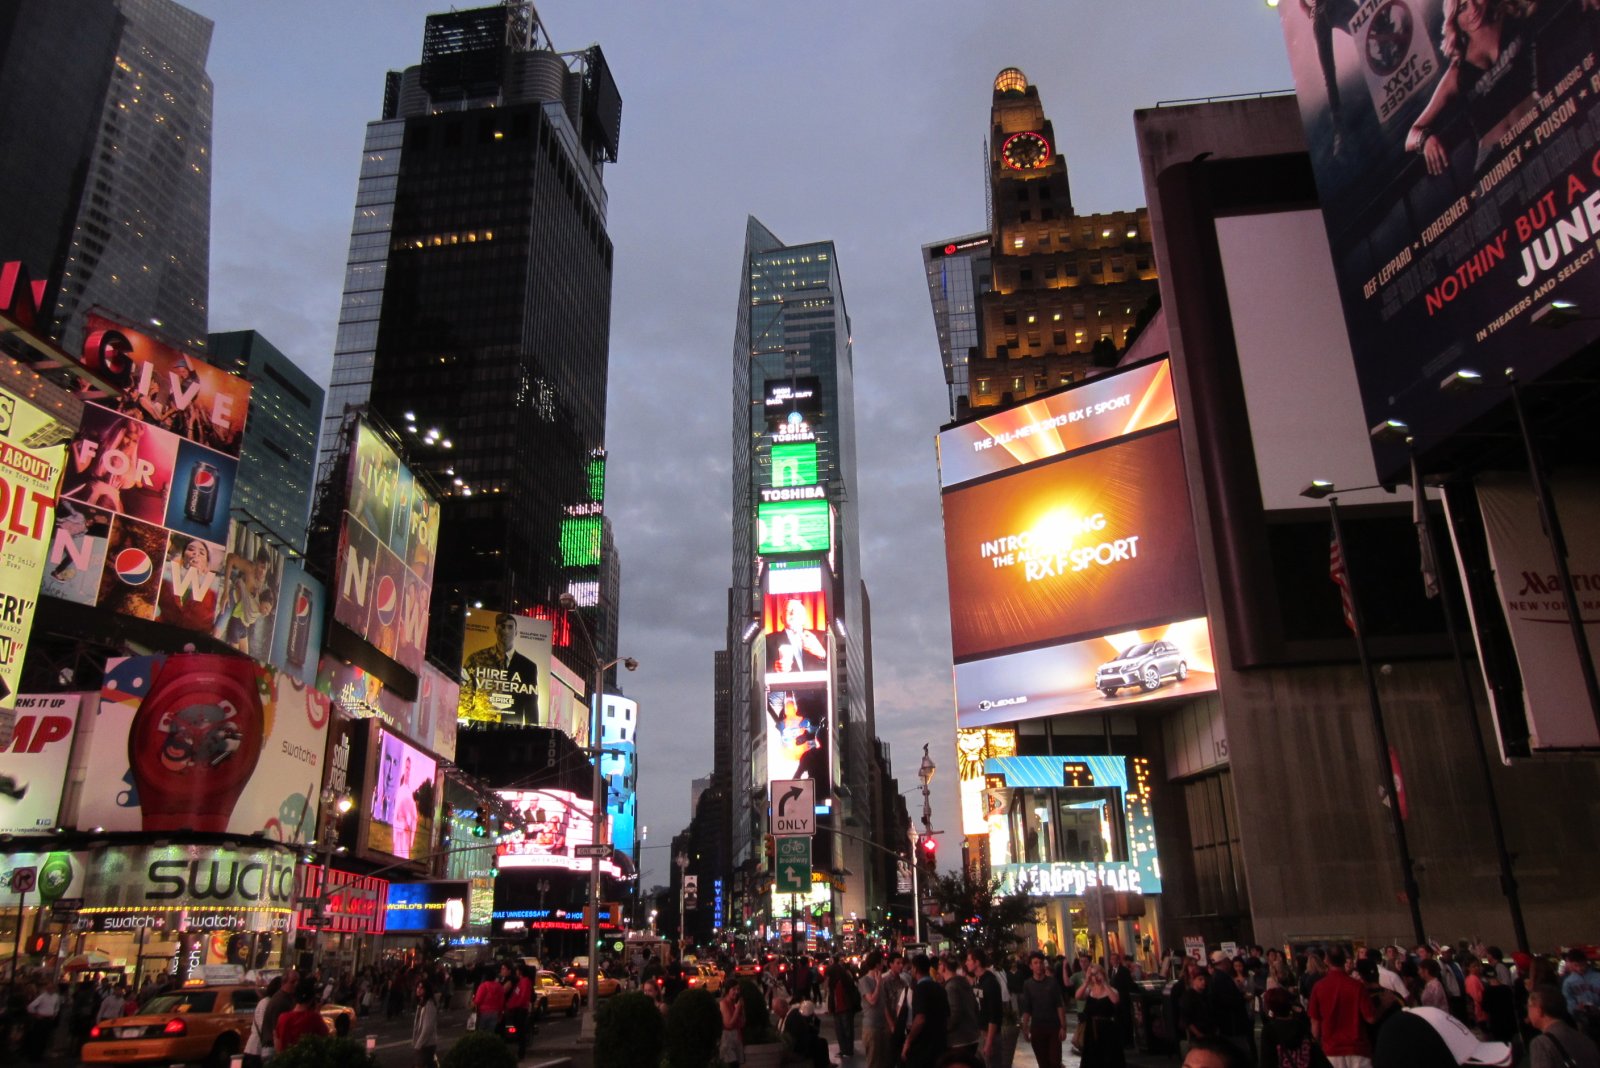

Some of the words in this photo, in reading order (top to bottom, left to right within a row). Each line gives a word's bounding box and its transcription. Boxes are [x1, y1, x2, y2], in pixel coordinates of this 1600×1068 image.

[1380, 60, 1432, 118] STACEE
[1383, 54, 1418, 97] JAXX
[1499, 106, 1539, 149] FEATURING
[1539, 91, 1555, 111] THE
[1554, 65, 1583, 97] MUSIC
[1582, 52, 1595, 71] OF
[1363, 279, 1378, 299] DEF
[1378, 245, 1412, 287] LEPPARD
[1420, 195, 1469, 249] FOREIGNER
[1478, 147, 1523, 197] JOURNEY
[1534, 96, 1577, 145] POISON
[1425, 228, 1508, 317] NOTHIN'
[1515, 190, 1557, 242] BUT
[1568, 174, 1587, 205] A
[1517, 190, 1600, 288] JUNE
[1476, 328, 1488, 342] IN
[1487, 298, 1532, 334] THEATERS
[1533, 280, 1556, 301] AND
[1557, 248, 1594, 281] SELECT
[139, 360, 234, 429] IVE
[772, 432, 815, 443] TOSHIBA
[779, 422, 808, 434] 2012
[973, 438, 992, 451] THE
[1068, 409, 1085, 423] RX
[1086, 407, 1093, 418] F
[1095, 394, 1131, 415] SPORT
[80, 439, 156, 487] FOR
[358, 455, 391, 508] LIVE
[762, 486, 824, 501] TOSHIBA
[992, 555, 1014, 568] THE
[1026, 557, 1054, 582] RX
[1057, 553, 1067, 575] F
[1070, 536, 1139, 571] SPORT
[1509, 601, 1538, 610] NEW
[476, 667, 508, 680] HIRE
[511, 672, 521, 682] A
[476, 677, 539, 695] VETERAN
[38, 699, 49, 707] IT
[50, 699, 65, 708] UP
[282, 740, 311, 764] swatch
[777, 820, 808, 830] ONLY
[104, 915, 155, 929] swatch
